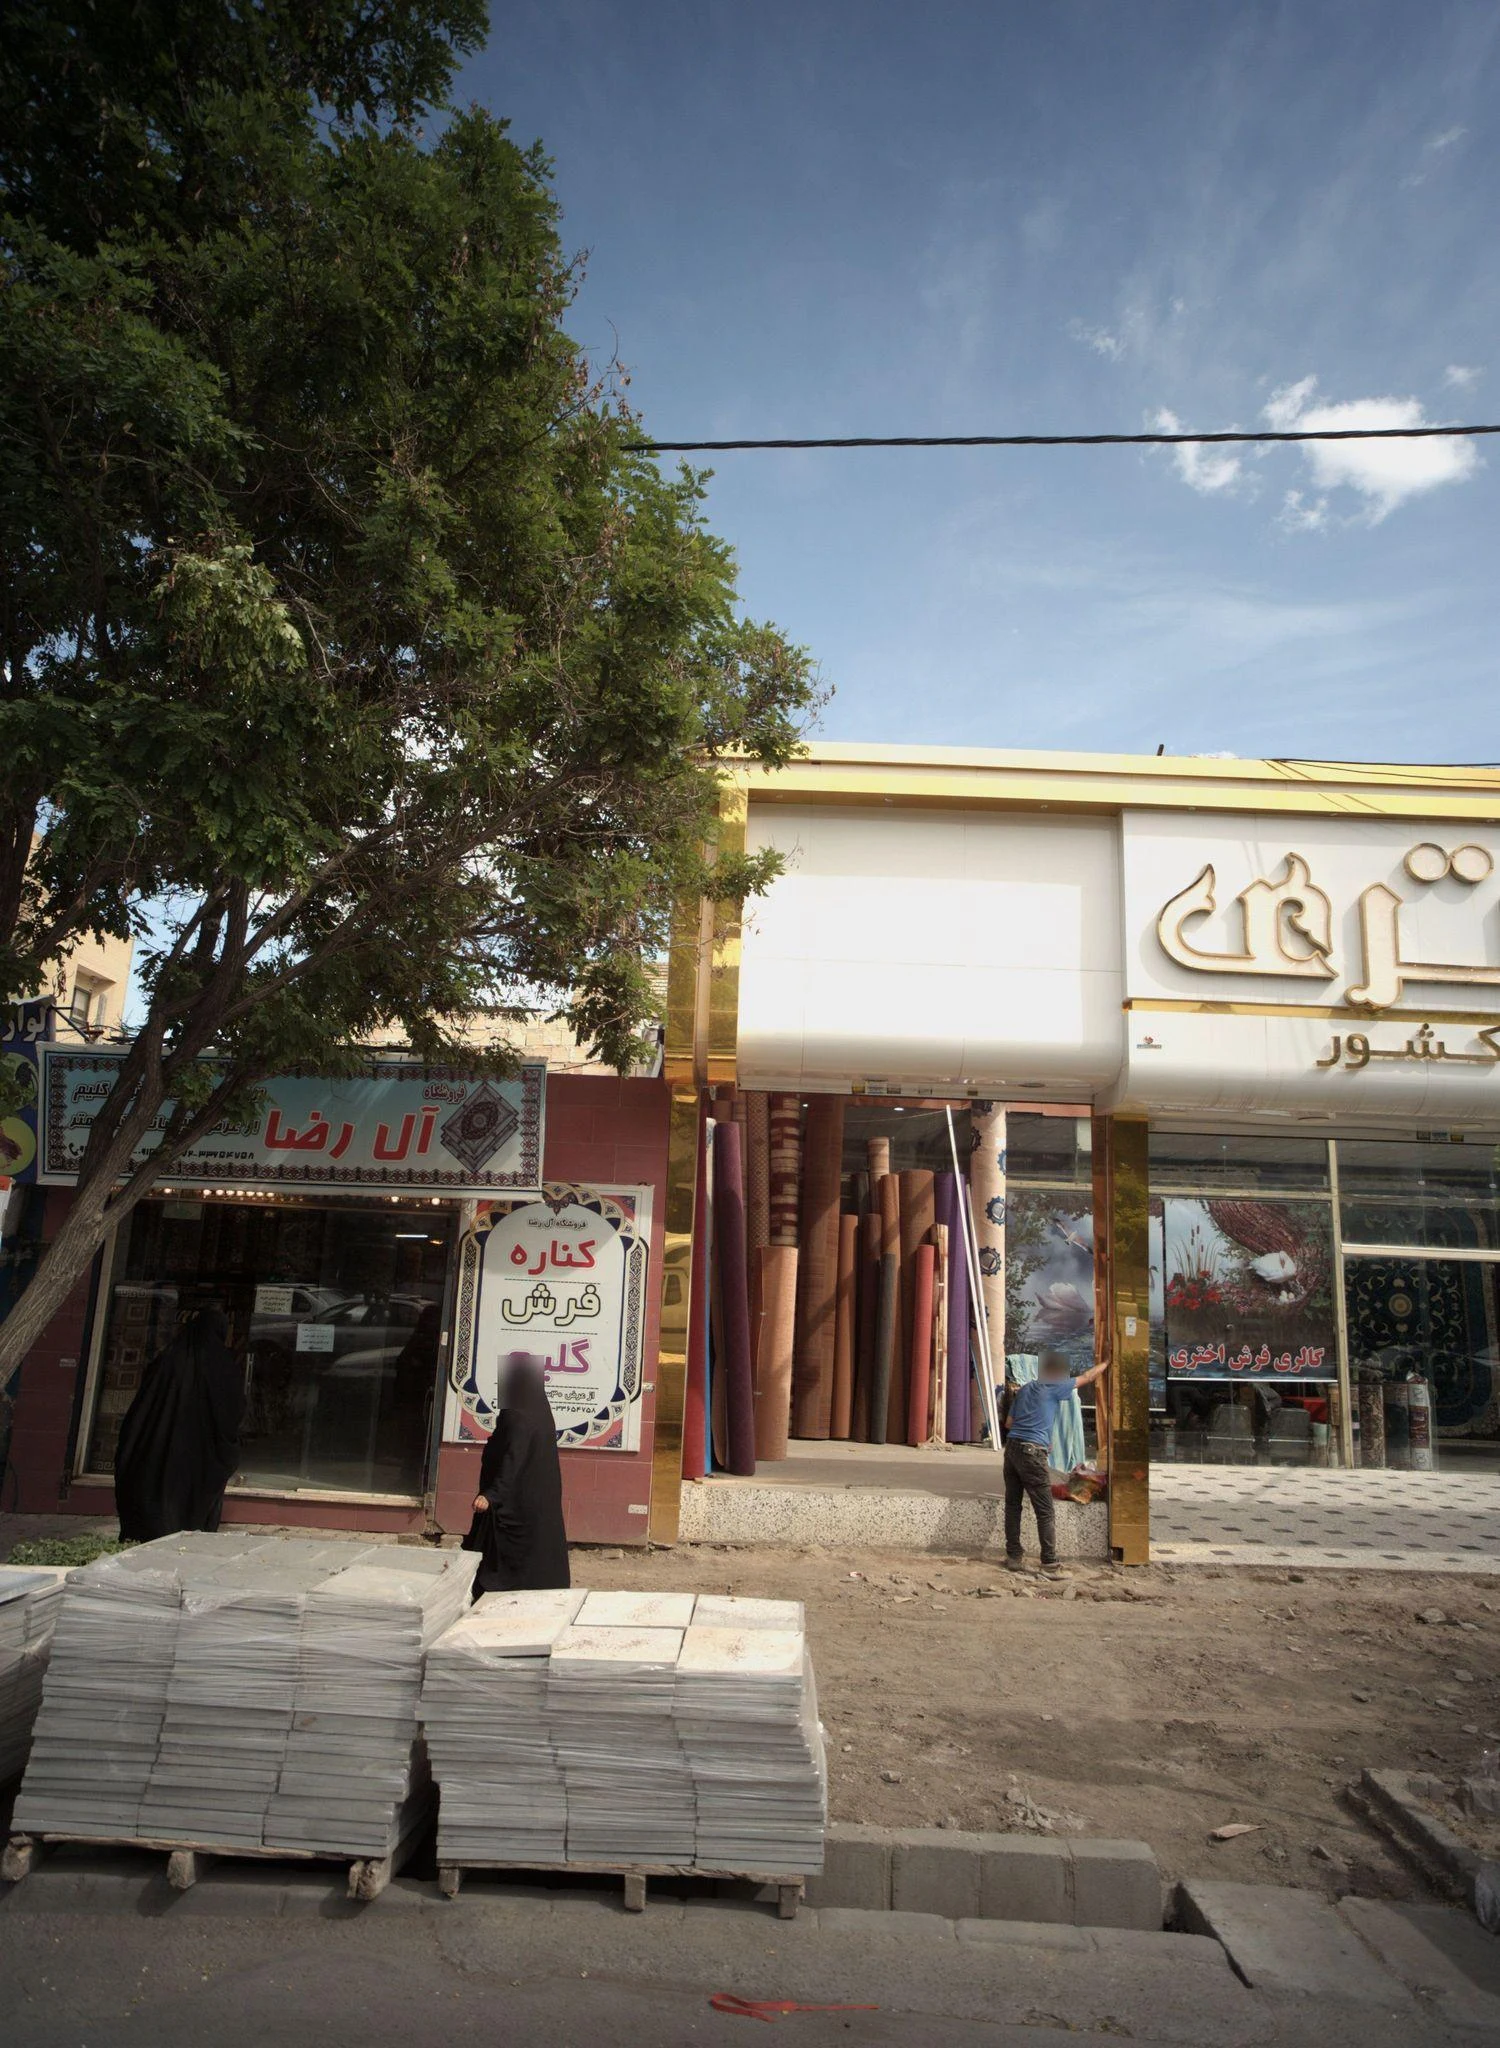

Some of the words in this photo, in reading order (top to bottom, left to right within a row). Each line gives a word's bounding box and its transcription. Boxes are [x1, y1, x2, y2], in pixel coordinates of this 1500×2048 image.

[424, 1084, 466, 1104] فروشگاه
[264, 1109, 354, 1160] رضا
[372, 1105, 441, 1160] آل
[528, 1219, 542, 1228] رضا
[544, 1218, 554, 1228] آل
[555, 1219, 586, 1229] فروشگاه
[511, 1240, 595, 1275] کناره
[502, 1283, 600, 1326] فرش
[508, 1338, 589, 1382] گلی
[1169, 1343, 1226, 1370] اختری
[1228, 1344, 1271, 1371] فرش
[564, 1390, 586, 1401] عرض
[586, 1391, 596, 1401] از
